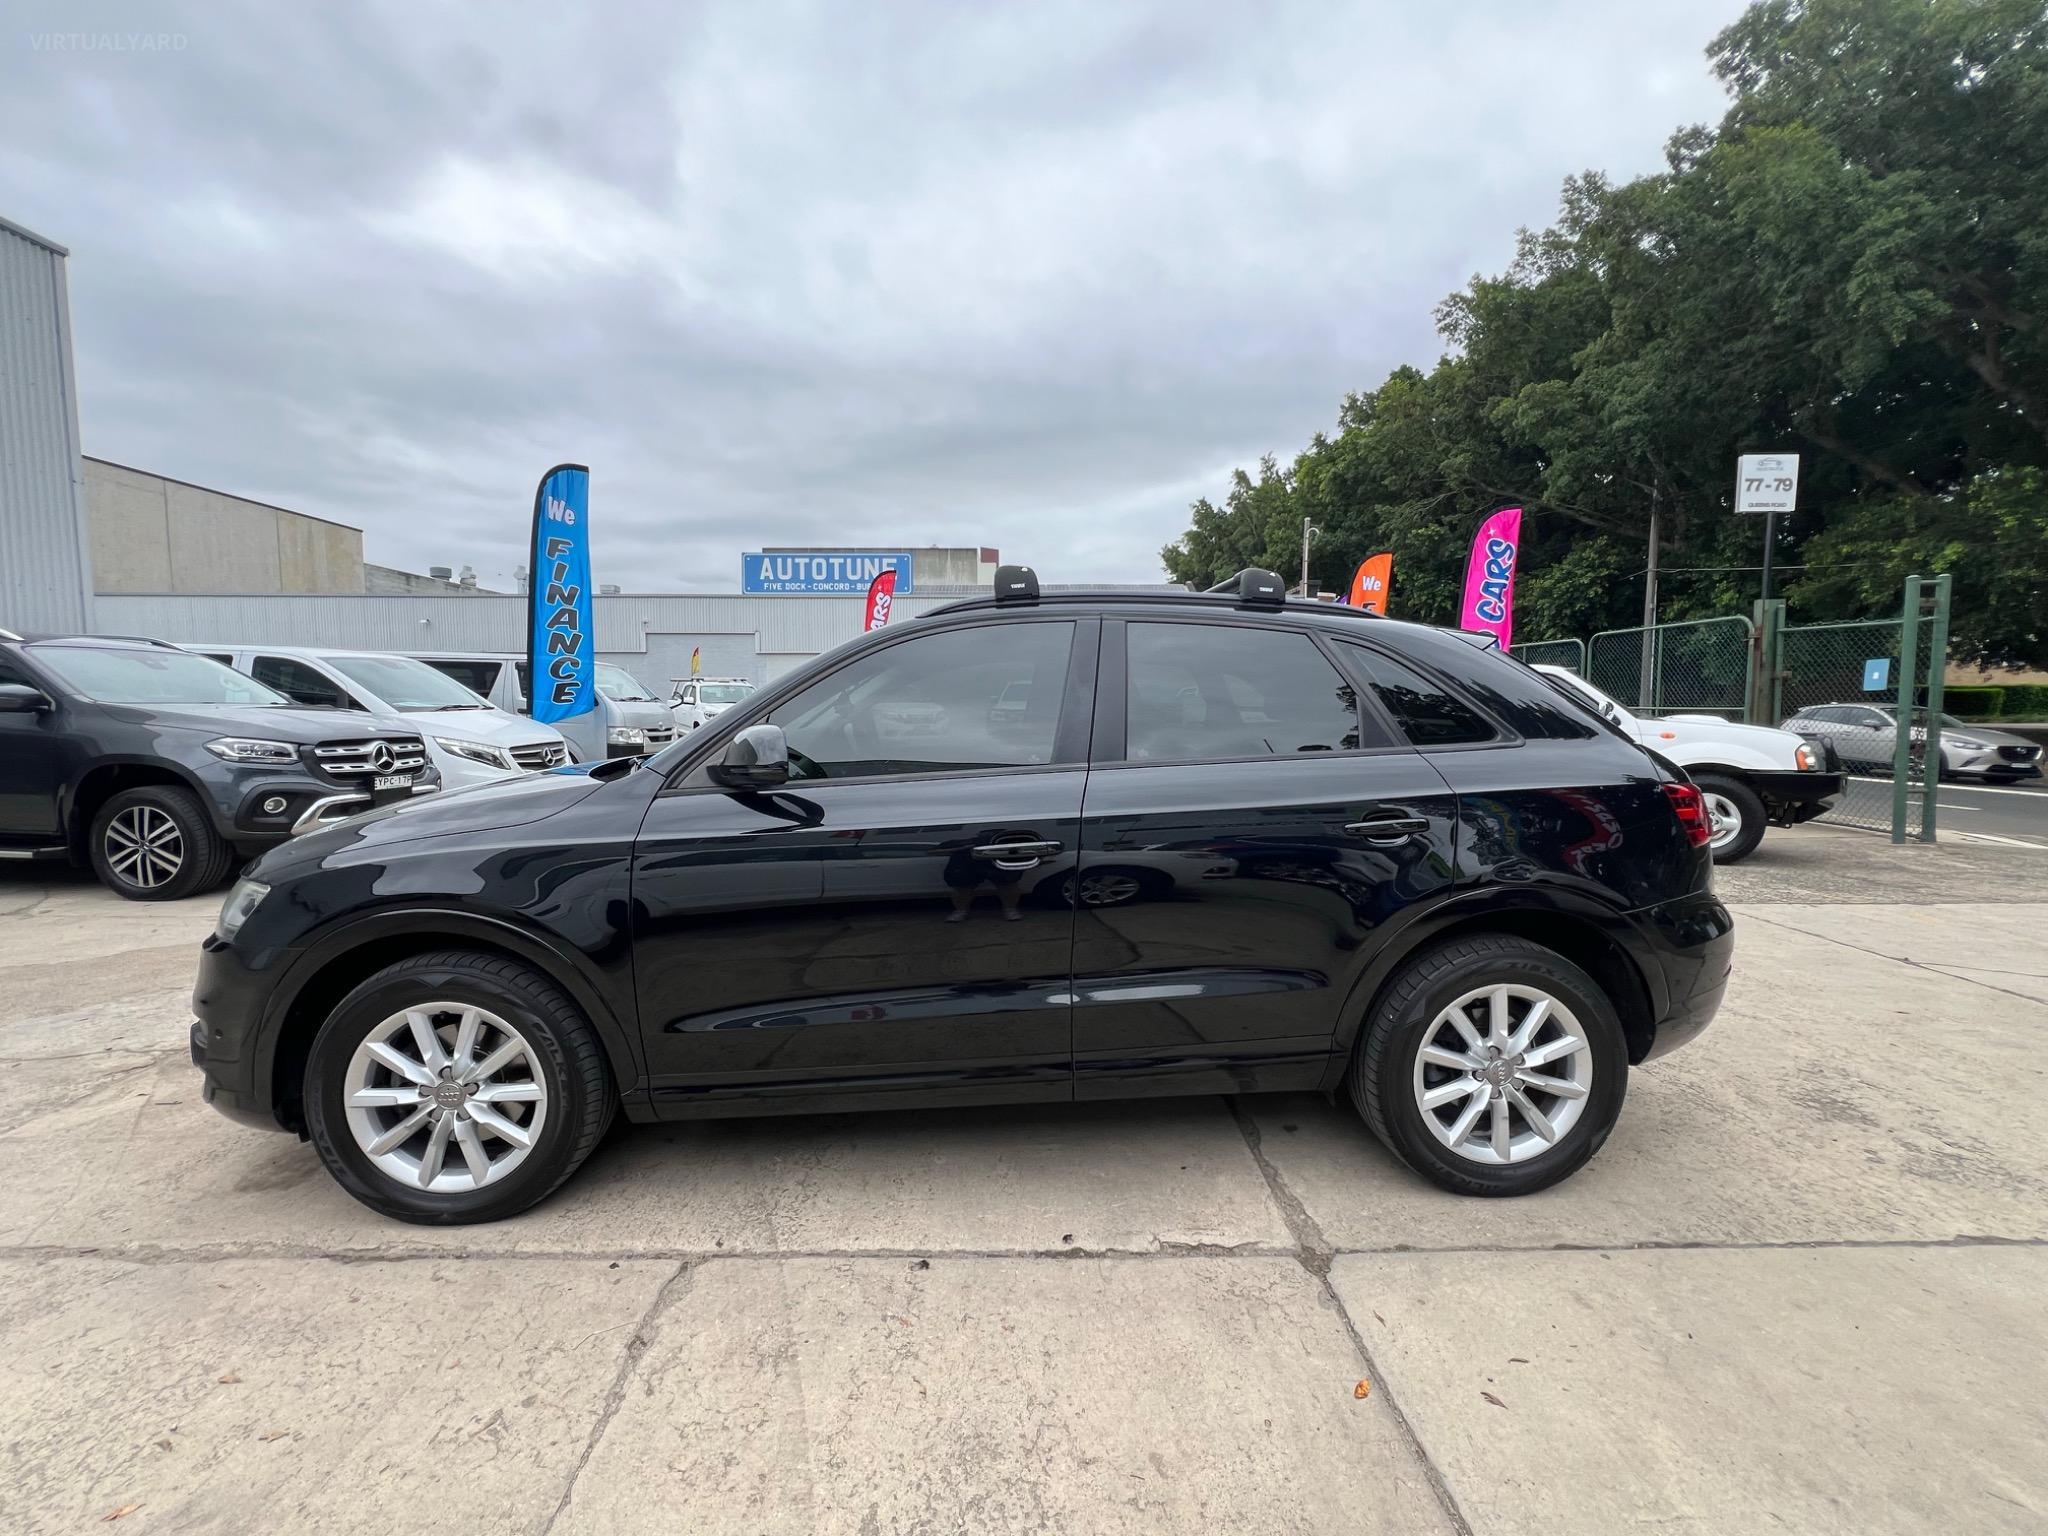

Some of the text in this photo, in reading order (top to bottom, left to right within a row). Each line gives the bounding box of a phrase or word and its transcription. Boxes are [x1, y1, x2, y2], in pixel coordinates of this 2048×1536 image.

[547, 496, 576, 526] We
[764, 582, 783, 591] FIVE
[1362, 576, 1382, 591] We
[1475, 538, 1516, 623] CARS
[545, 537, 584, 704] FINANCE
